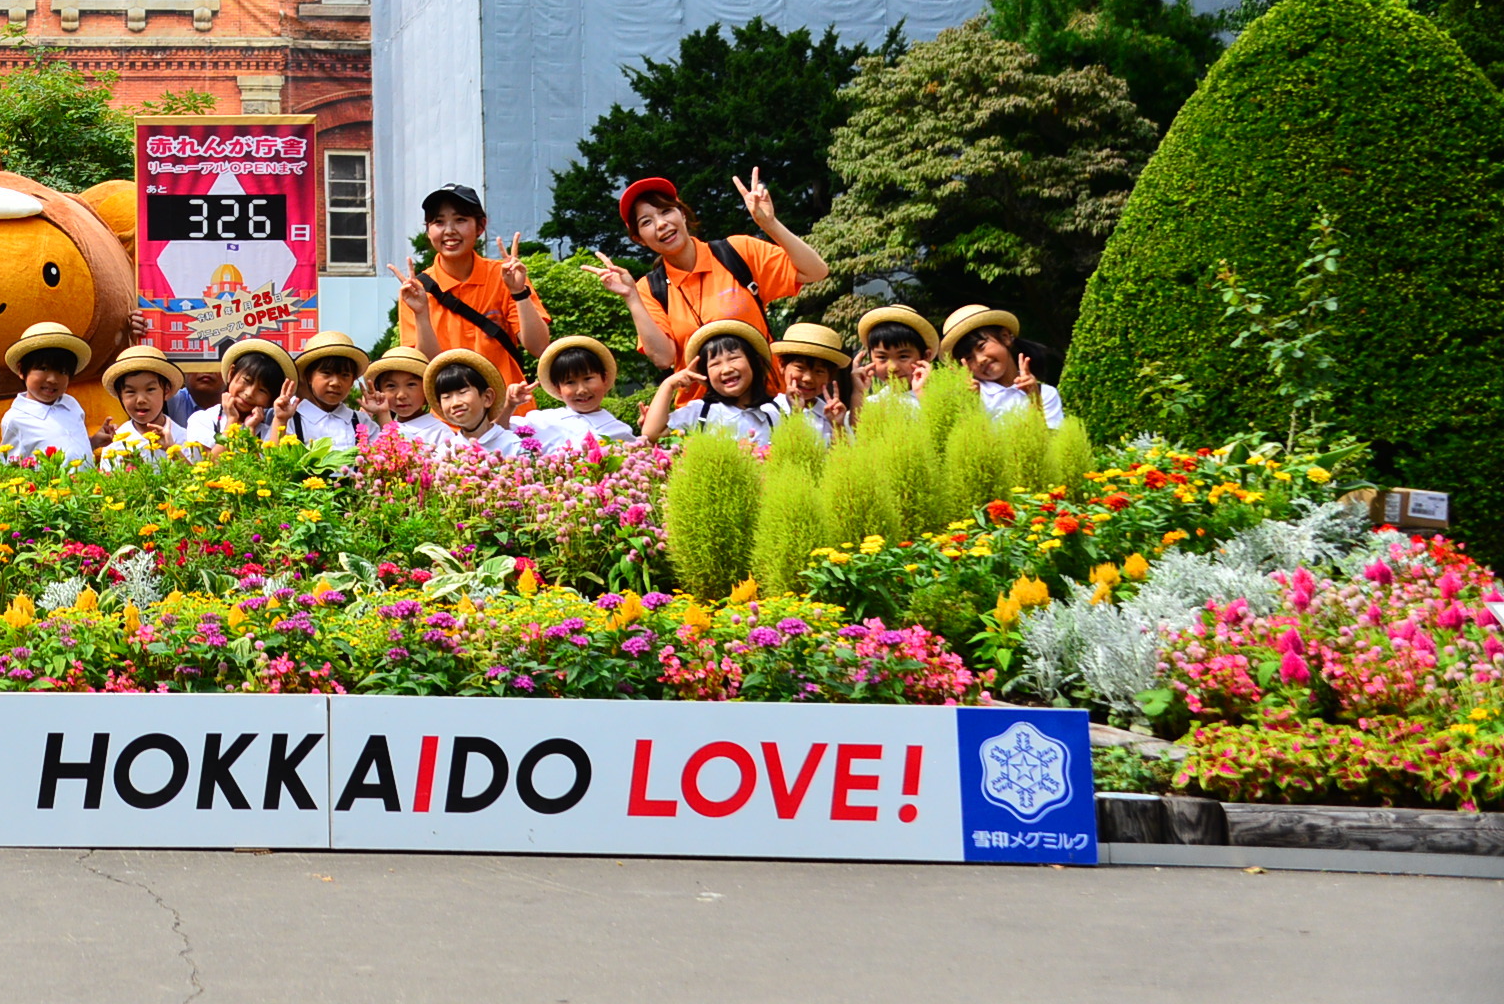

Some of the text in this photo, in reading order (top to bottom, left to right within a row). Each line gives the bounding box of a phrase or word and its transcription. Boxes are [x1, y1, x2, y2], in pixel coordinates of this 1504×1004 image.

[147, 135, 307, 158] 赤れんが庁舎
[147, 161, 307, 175] リニューアルOPENまで
[146, 185, 167, 194] あと
[189, 199, 311, 242] 326 日
[37, 732, 923, 824] HOKKAIDO LOVE!
[972, 830, 1089, 850] 雪印メグミルク
